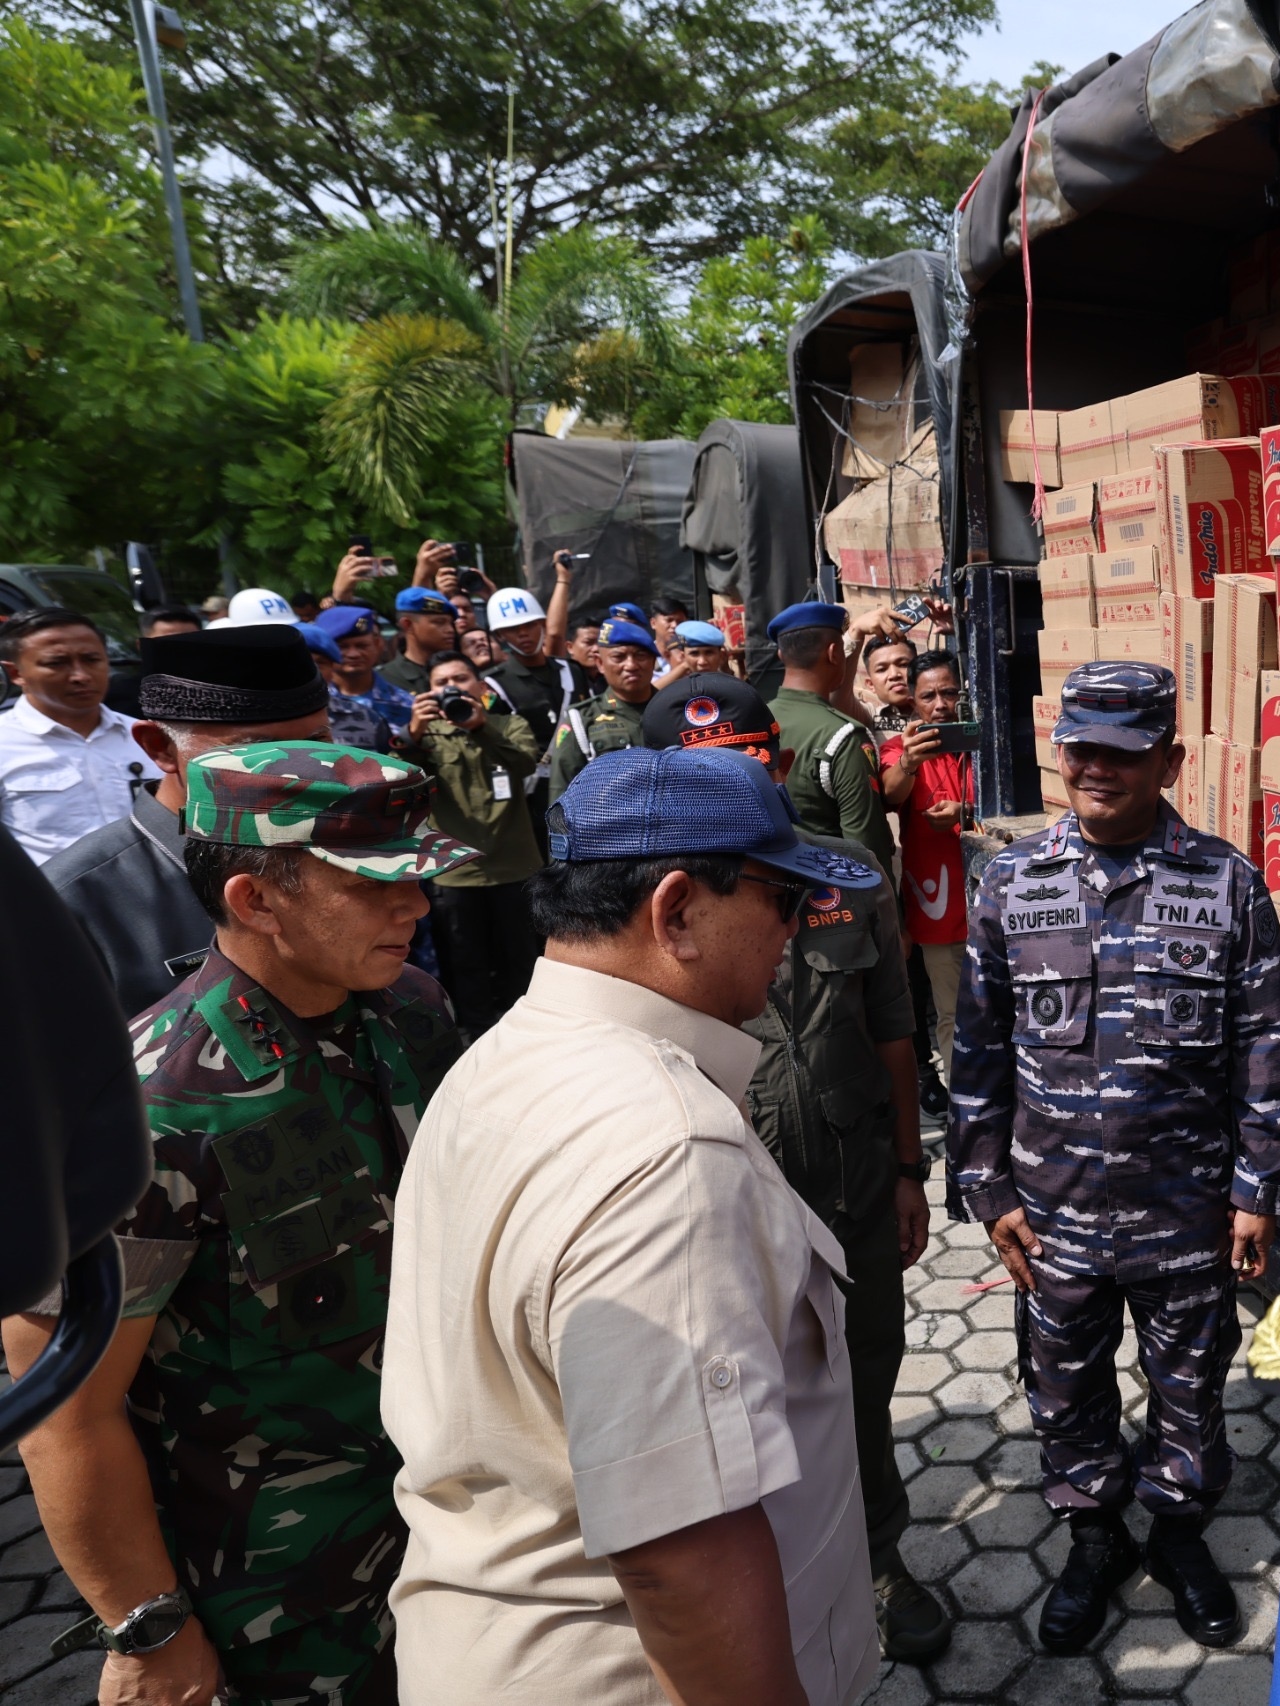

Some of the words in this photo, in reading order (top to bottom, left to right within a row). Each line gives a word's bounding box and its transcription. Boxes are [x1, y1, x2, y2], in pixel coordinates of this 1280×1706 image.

[1248, 469, 1265, 538] goreng
[1233, 526, 1241, 559] Instan
[1248, 539, 1263, 569] Mi
[1234, 560, 1242, 570] Mi
[498, 597, 529, 618] PM
[806, 910, 854, 928] BNPB
[1007, 906, 1081, 931] SYUFENRI
[1154, 903, 1189, 924] TNI
[1194, 906, 1224, 927] AL
[244, 1145, 354, 1217] HASAN
